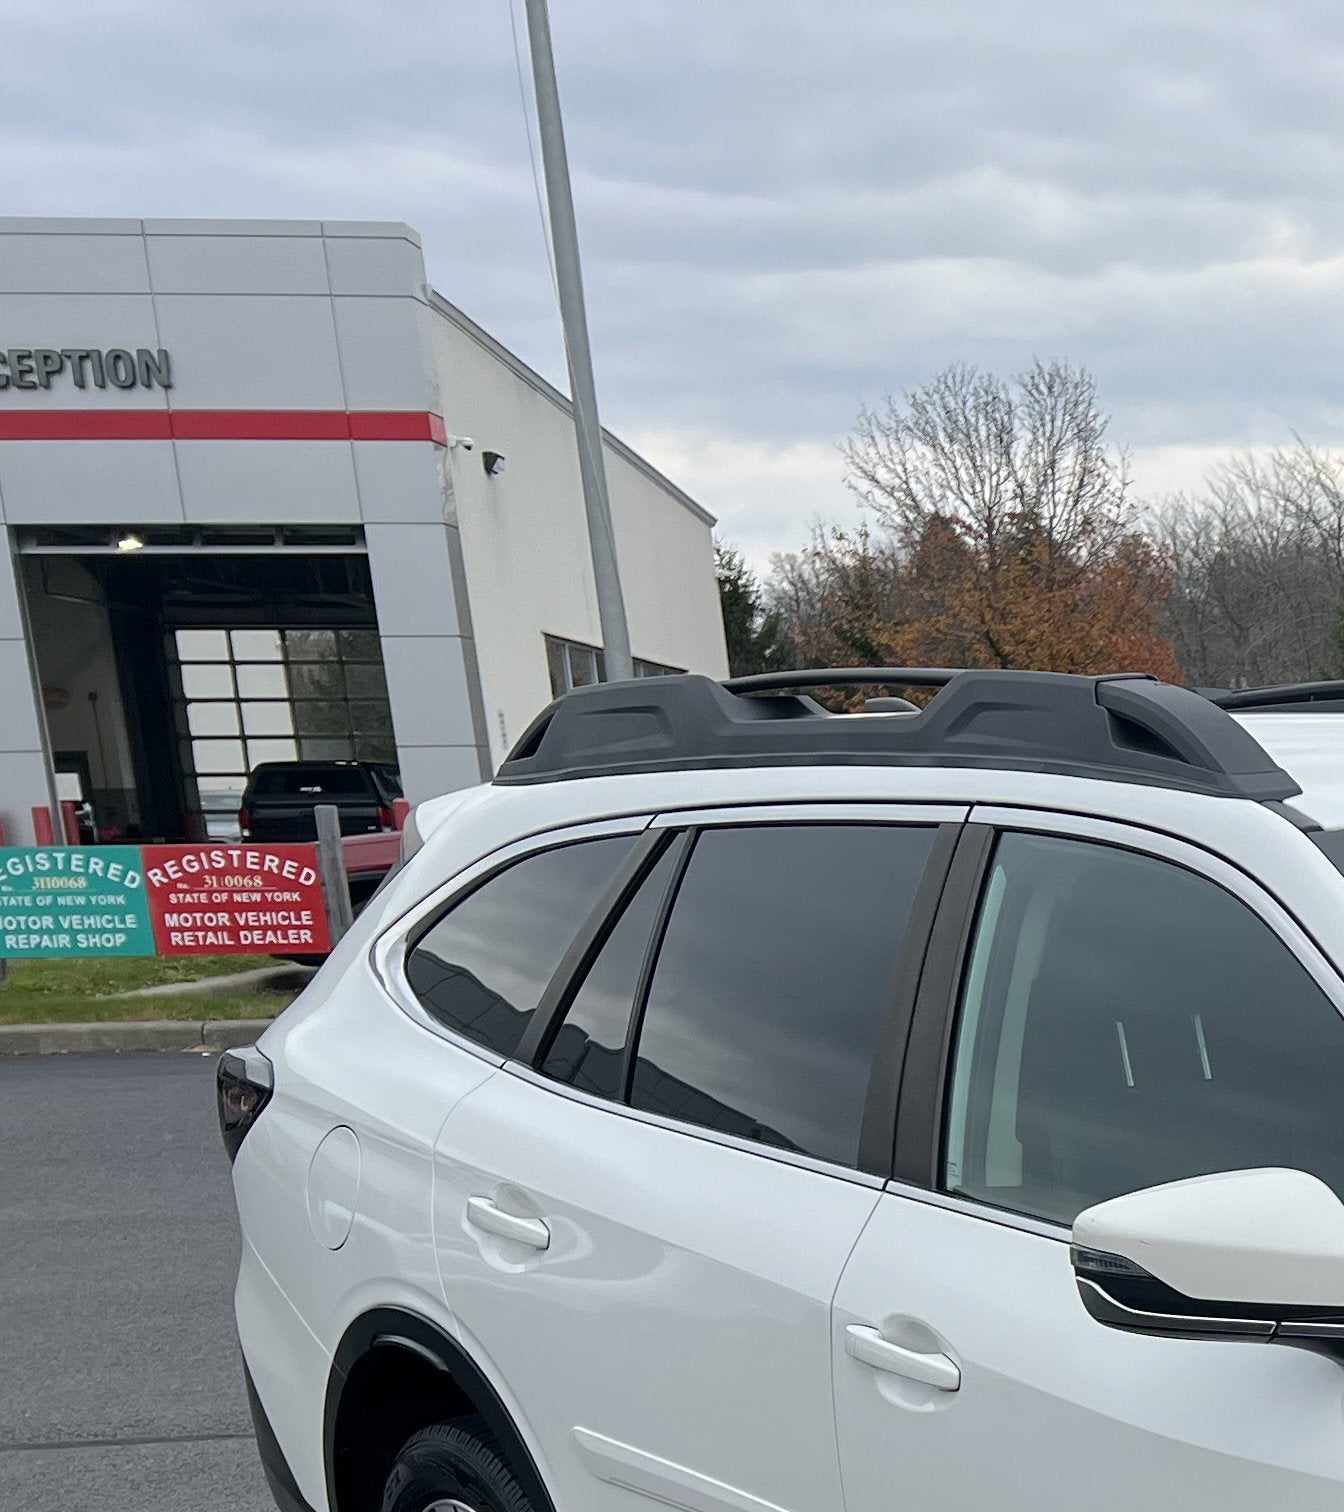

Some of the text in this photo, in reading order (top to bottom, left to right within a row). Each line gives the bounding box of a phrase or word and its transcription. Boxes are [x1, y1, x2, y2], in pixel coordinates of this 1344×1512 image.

[147, 850, 317, 888] REGISTERED
[0, 895, 125, 907] TATE OF NEW YORK
[169, 892, 301, 904] STATE OF NEW YORK
[0, 914, 137, 930] OTOR VEHICLE
[164, 911, 313, 927] MOTOR VEHICLE
[5, 933, 126, 949] REPAIR SHOP
[171, 930, 313, 946] RETAIL DEALER
